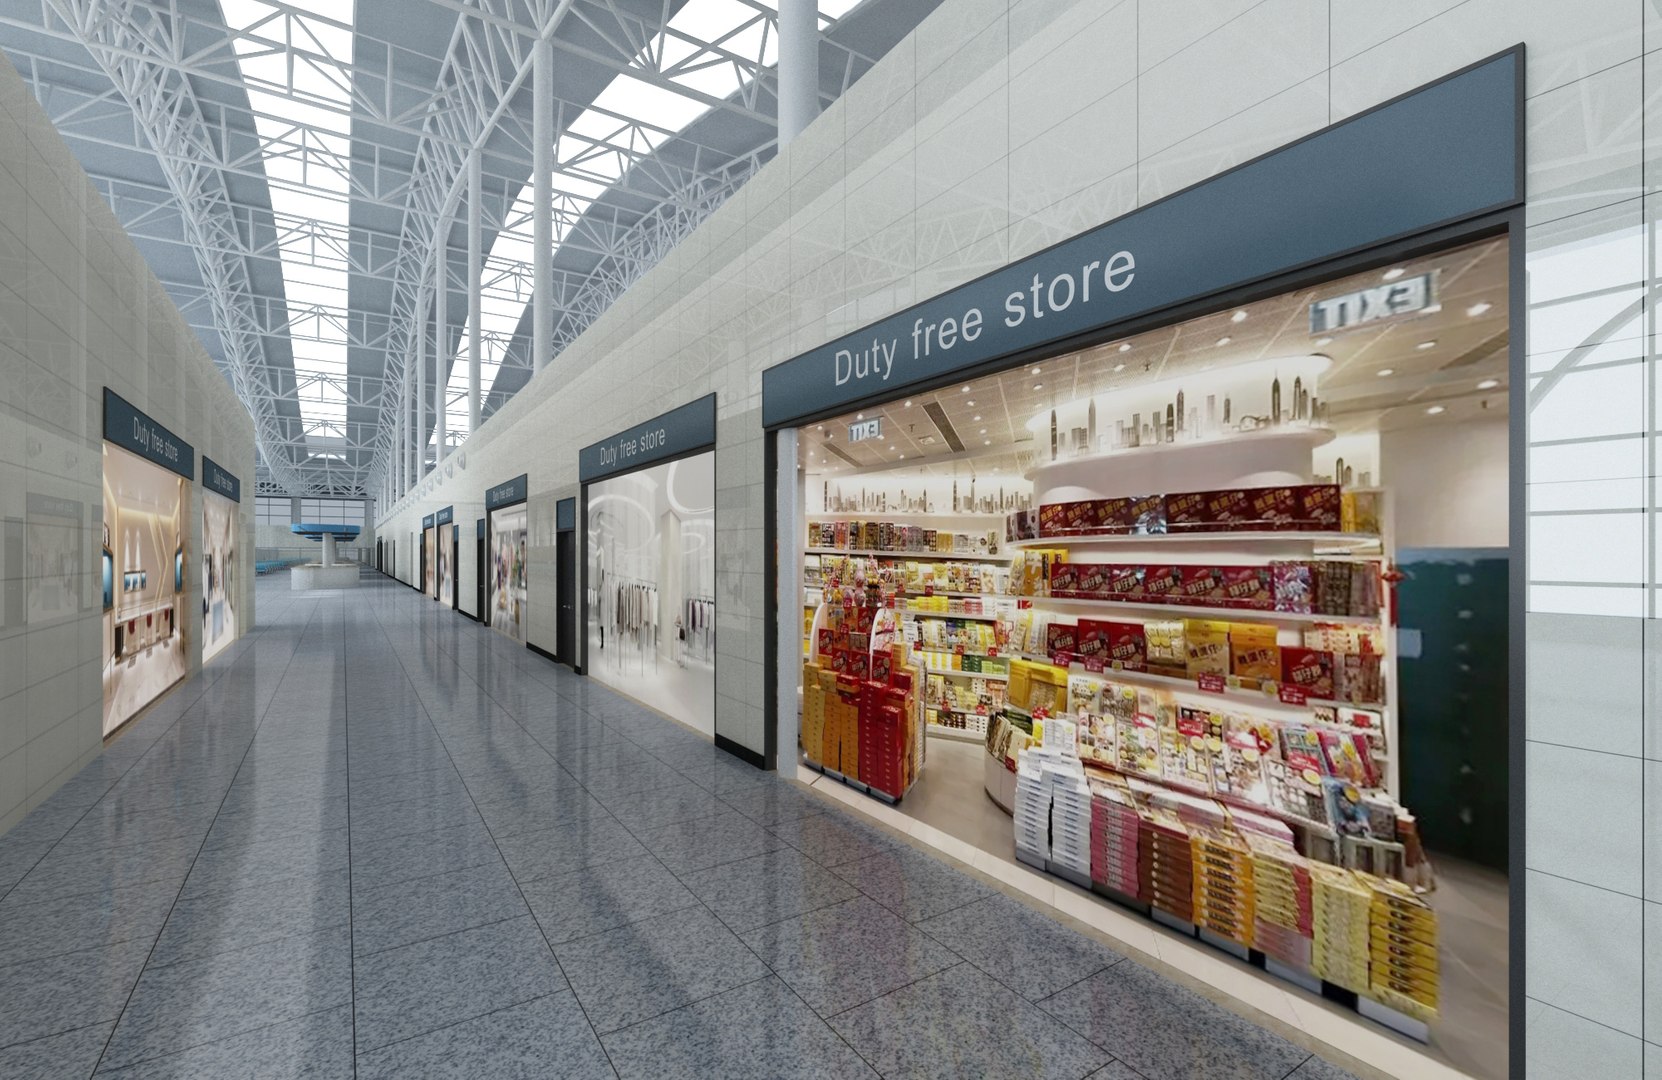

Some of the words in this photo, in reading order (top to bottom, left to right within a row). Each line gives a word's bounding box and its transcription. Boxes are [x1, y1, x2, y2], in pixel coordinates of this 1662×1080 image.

[835, 338, 897, 386] Duty
[912, 308, 983, 360] free
[1004, 250, 1136, 328] store
[133, 416, 150, 452] Duty
[152, 428, 163, 455] free
[164, 439, 179, 462] store
[600, 446, 618, 467] Duty
[620, 439, 637, 461] free
[640, 427, 666, 453] store
